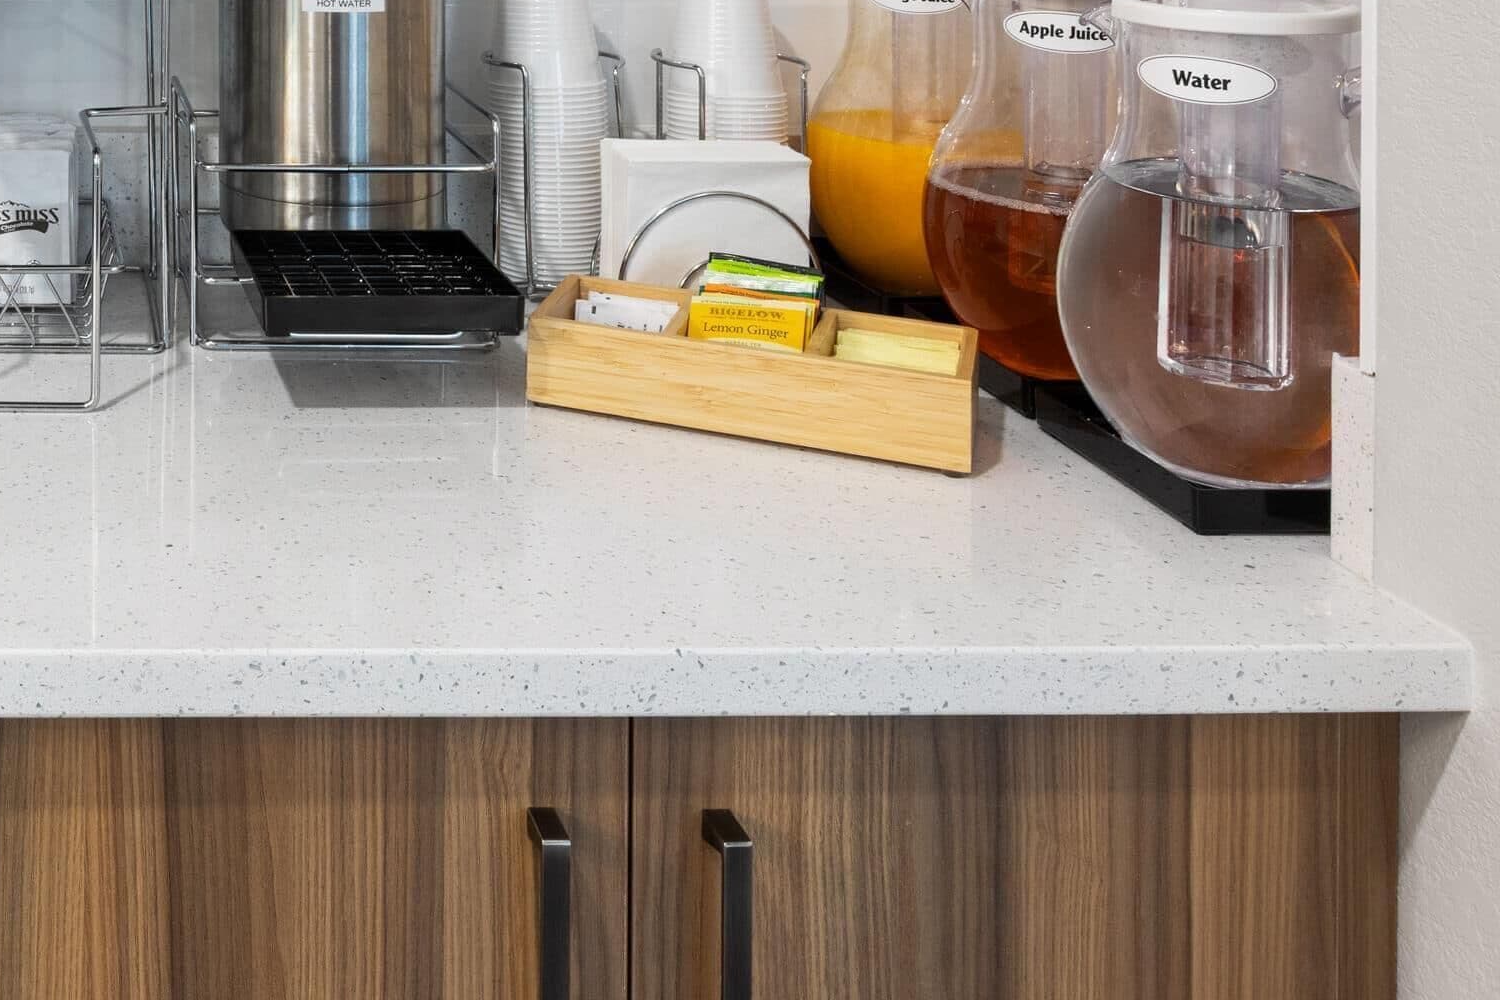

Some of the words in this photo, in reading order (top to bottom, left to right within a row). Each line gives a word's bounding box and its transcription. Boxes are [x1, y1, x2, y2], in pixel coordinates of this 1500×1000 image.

[316, 0, 336, 8] HOT
[338, 0, 372, 8] WATER
[1019, 20, 1065, 40] Apple
[1068, 25, 1108, 41] Juice
[1171, 68, 1232, 91] Water
[709, 306, 783, 320] BIGELOW
[703, 322, 744, 334] Lemon
[747, 324, 789, 340] Ginger
